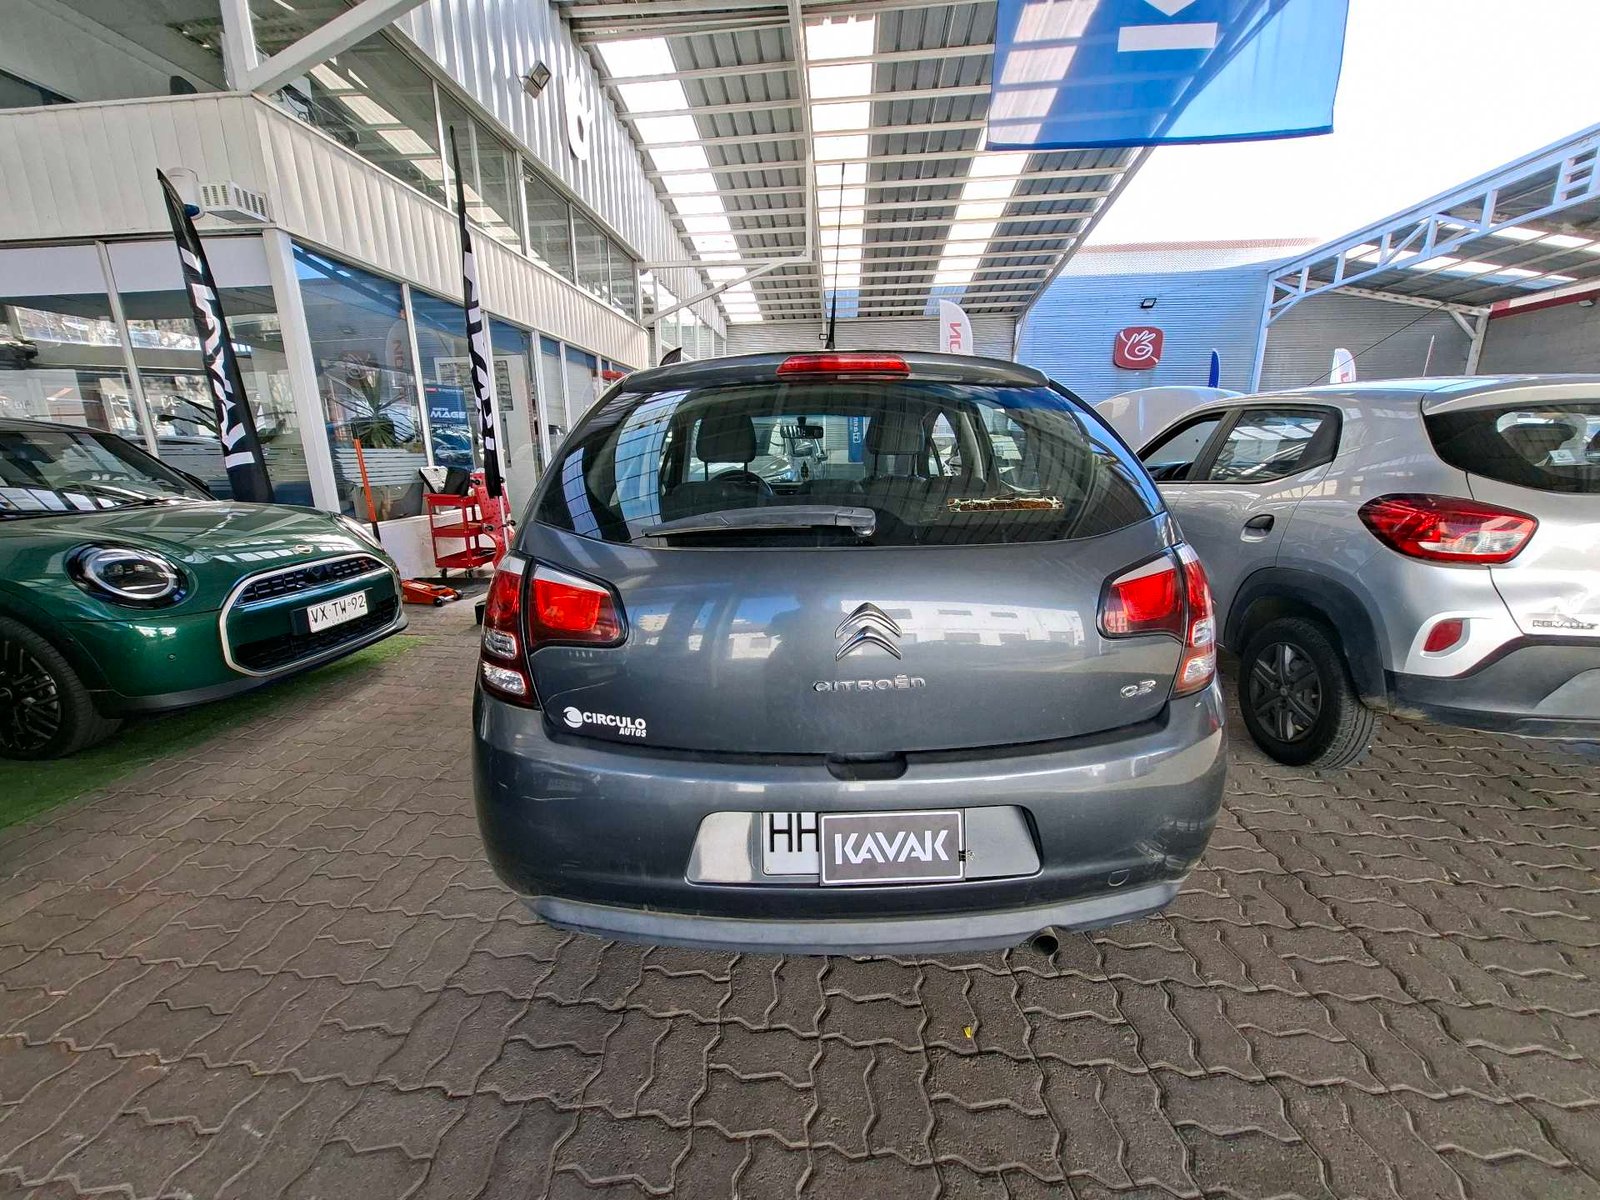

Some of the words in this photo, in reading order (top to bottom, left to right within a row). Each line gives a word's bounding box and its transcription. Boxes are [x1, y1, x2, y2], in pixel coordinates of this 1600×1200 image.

[430, 410, 467, 419] MAGE
[582, 711, 647, 730] CIRCULO
[619, 727, 647, 738] AUTOS
[834, 829, 950, 865] KAVAK
